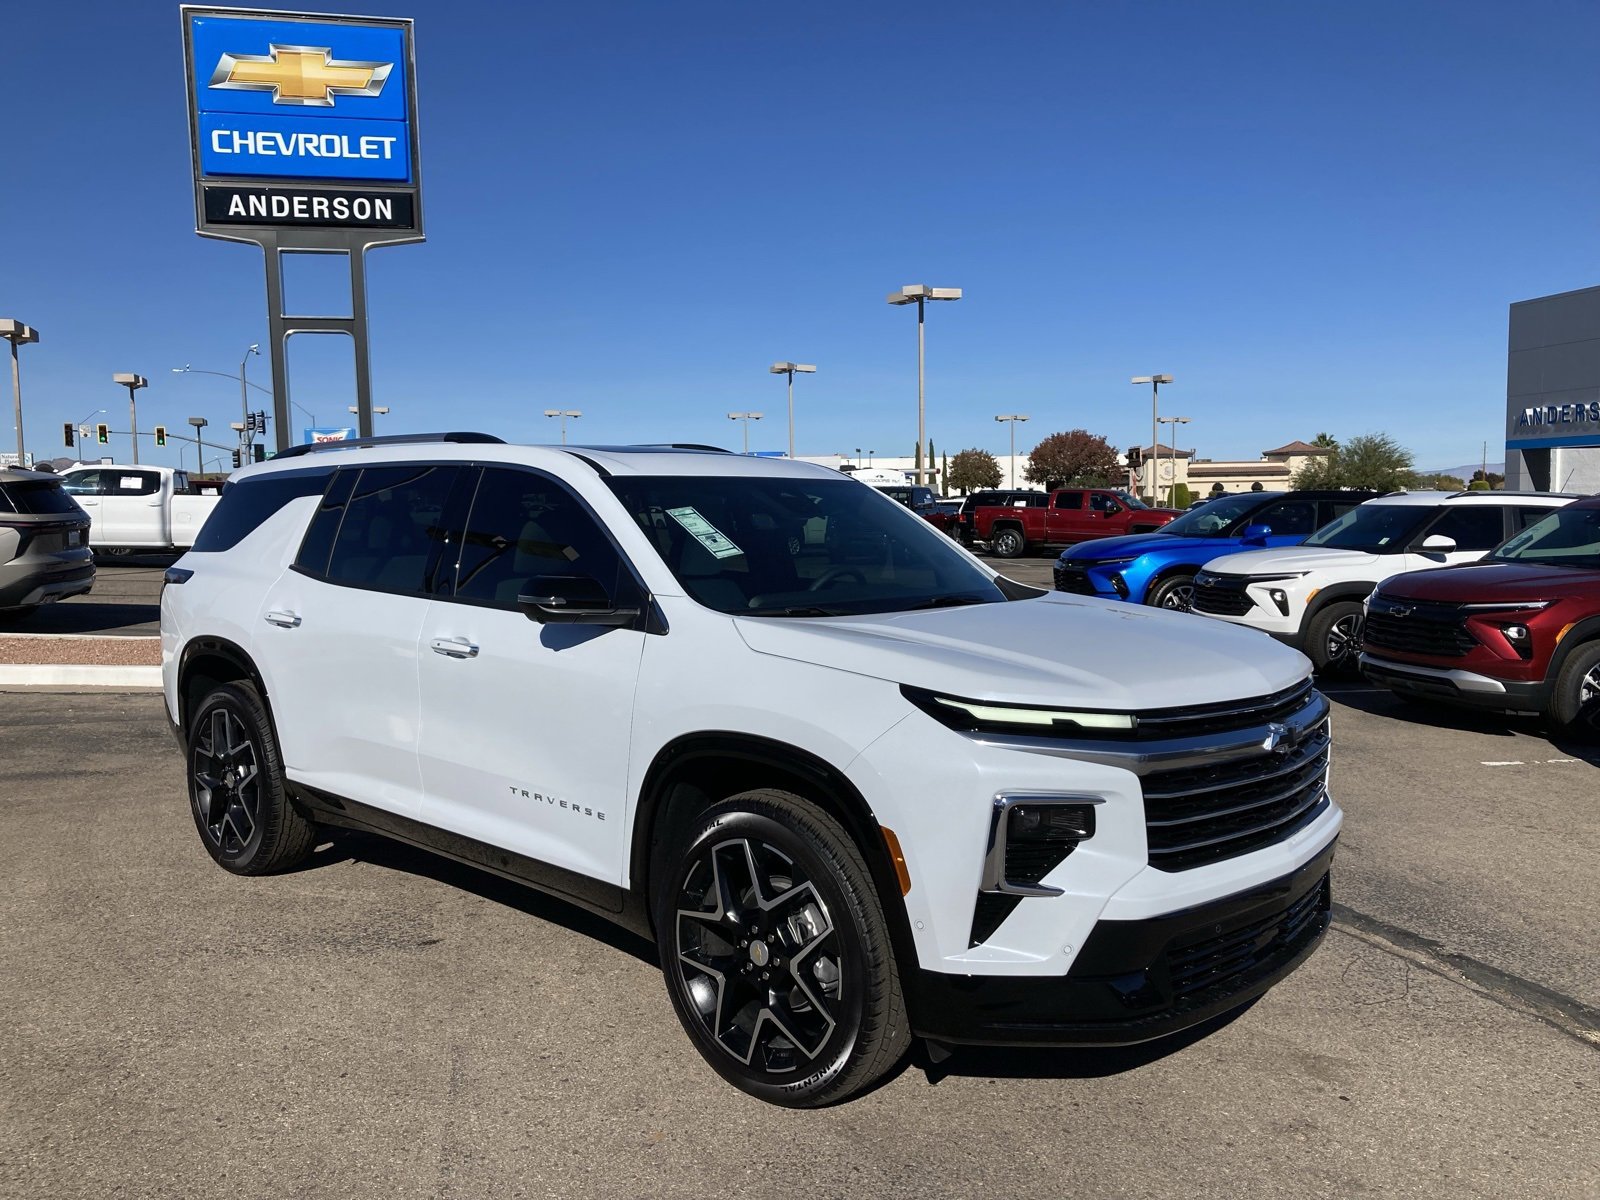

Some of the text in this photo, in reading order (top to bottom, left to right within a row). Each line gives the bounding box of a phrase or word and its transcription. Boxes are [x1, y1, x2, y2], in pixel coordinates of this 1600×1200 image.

[211, 129, 396, 160] CHEVROLET
[228, 194, 393, 220] ANDERSON
[1520, 401, 1600, 427] ANDERS
[509, 786, 605, 820] TRAVERSE
